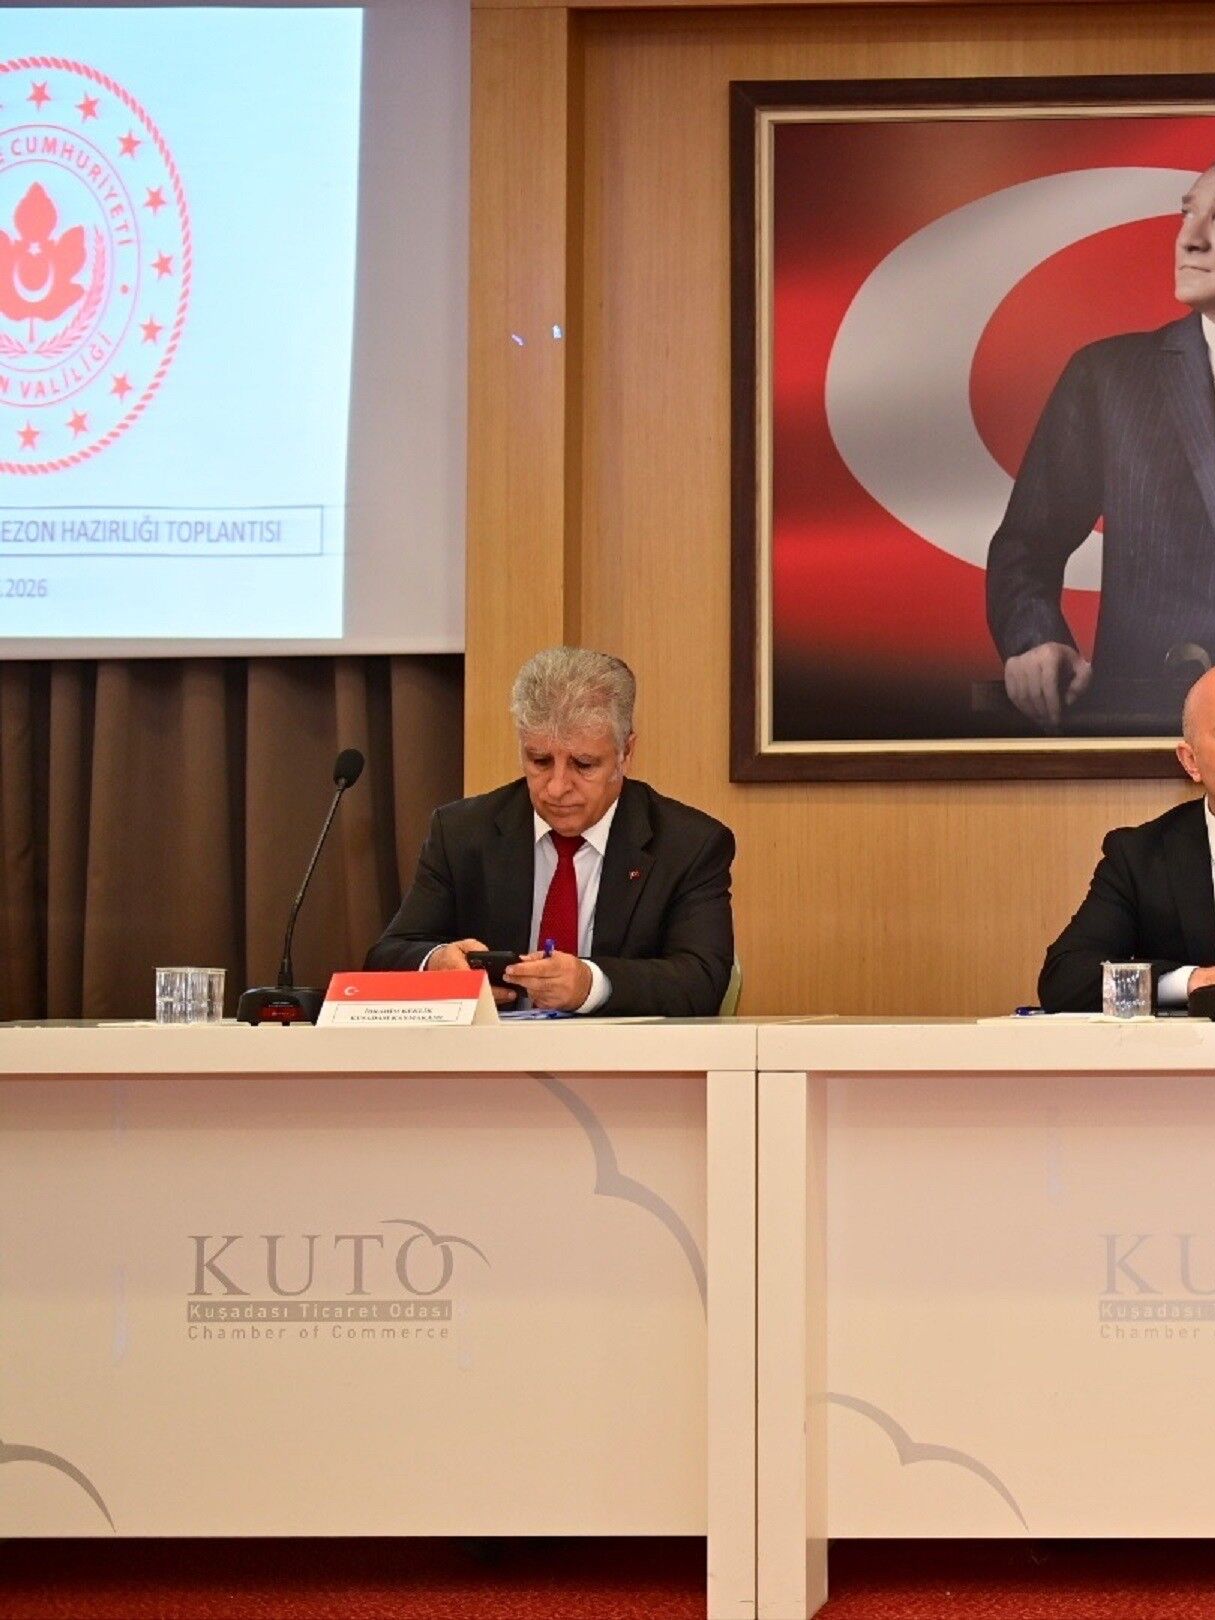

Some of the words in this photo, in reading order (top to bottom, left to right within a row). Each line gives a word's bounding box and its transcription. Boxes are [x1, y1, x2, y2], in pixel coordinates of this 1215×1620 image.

[0, 519, 55, 543] EZON
[61, 515, 160, 543] HAZIRLIĞI
[166, 520, 282, 543] TOPLANTISI
[187, 1234, 453, 1296] KUTO
[189, 1303, 289, 1320] Kuşadası
[301, 1303, 378, 1318] Ticaret
[389, 1303, 449, 1318] Odası
[1101, 1302, 1201, 1319] Kuşadası
[187, 1325, 286, 1340] Chamber
[299, 1325, 319, 1340] of
[331, 1325, 449, 1340] Commerce
[1100, 1324, 1201, 1339] Chamber
